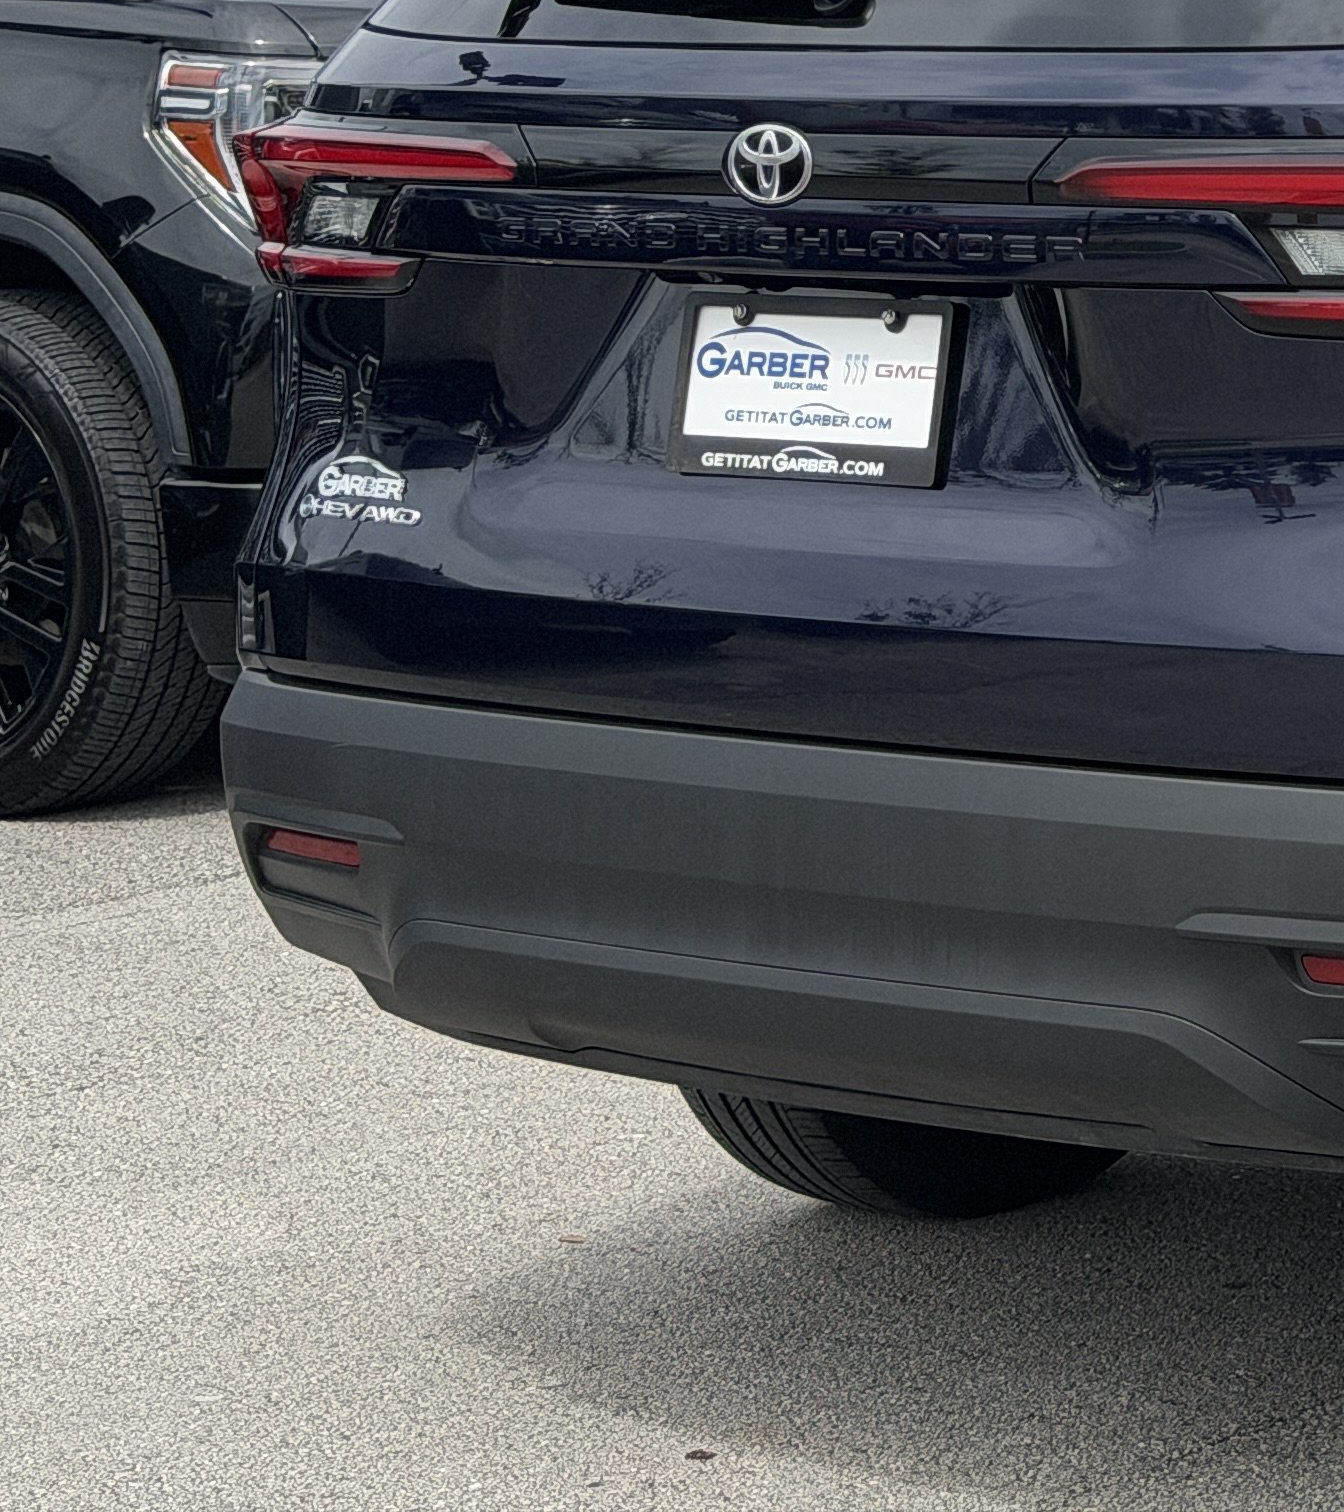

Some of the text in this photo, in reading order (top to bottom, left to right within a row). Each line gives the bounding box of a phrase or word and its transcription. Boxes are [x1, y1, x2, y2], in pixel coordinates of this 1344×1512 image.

[496, 215, 1085, 263] GRAND HIGHLANDER
[697, 342, 830, 379] GARBER
[875, 364, 937, 379] GMC
[773, 381, 827, 391] BUICK GMC
[318, 465, 404, 501] GARBER
[30, 638, 100, 761] BRIDGESTONE
